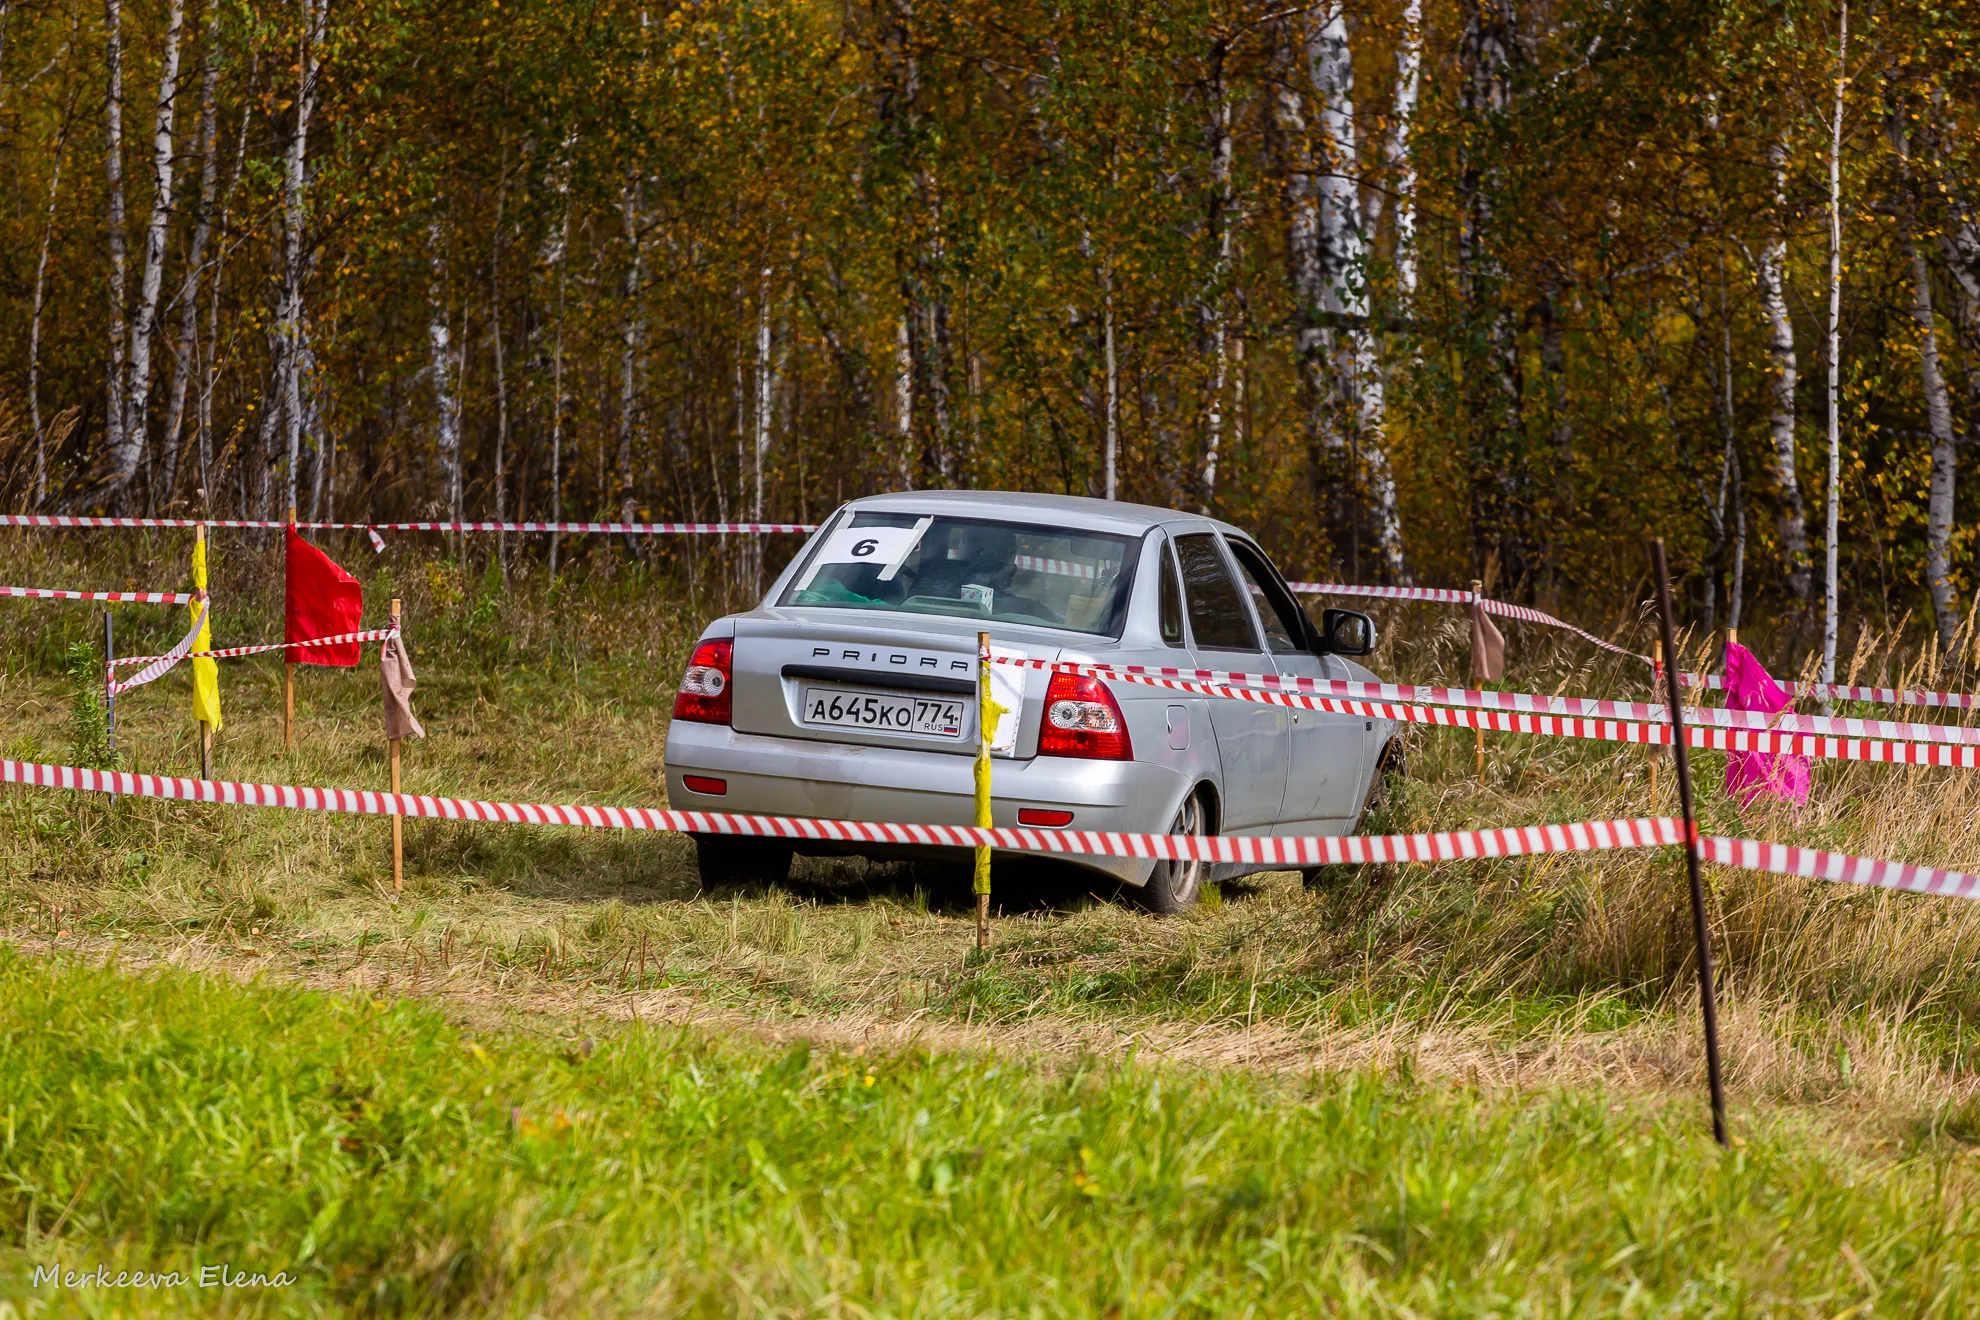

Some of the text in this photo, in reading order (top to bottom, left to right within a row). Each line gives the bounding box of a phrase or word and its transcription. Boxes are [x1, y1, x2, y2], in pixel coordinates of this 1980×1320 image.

[851, 539, 879, 557] 6
[812, 647, 969, 672] PRIORA
[916, 702, 955, 725] 774
[923, 722, 943, 732] RUS
